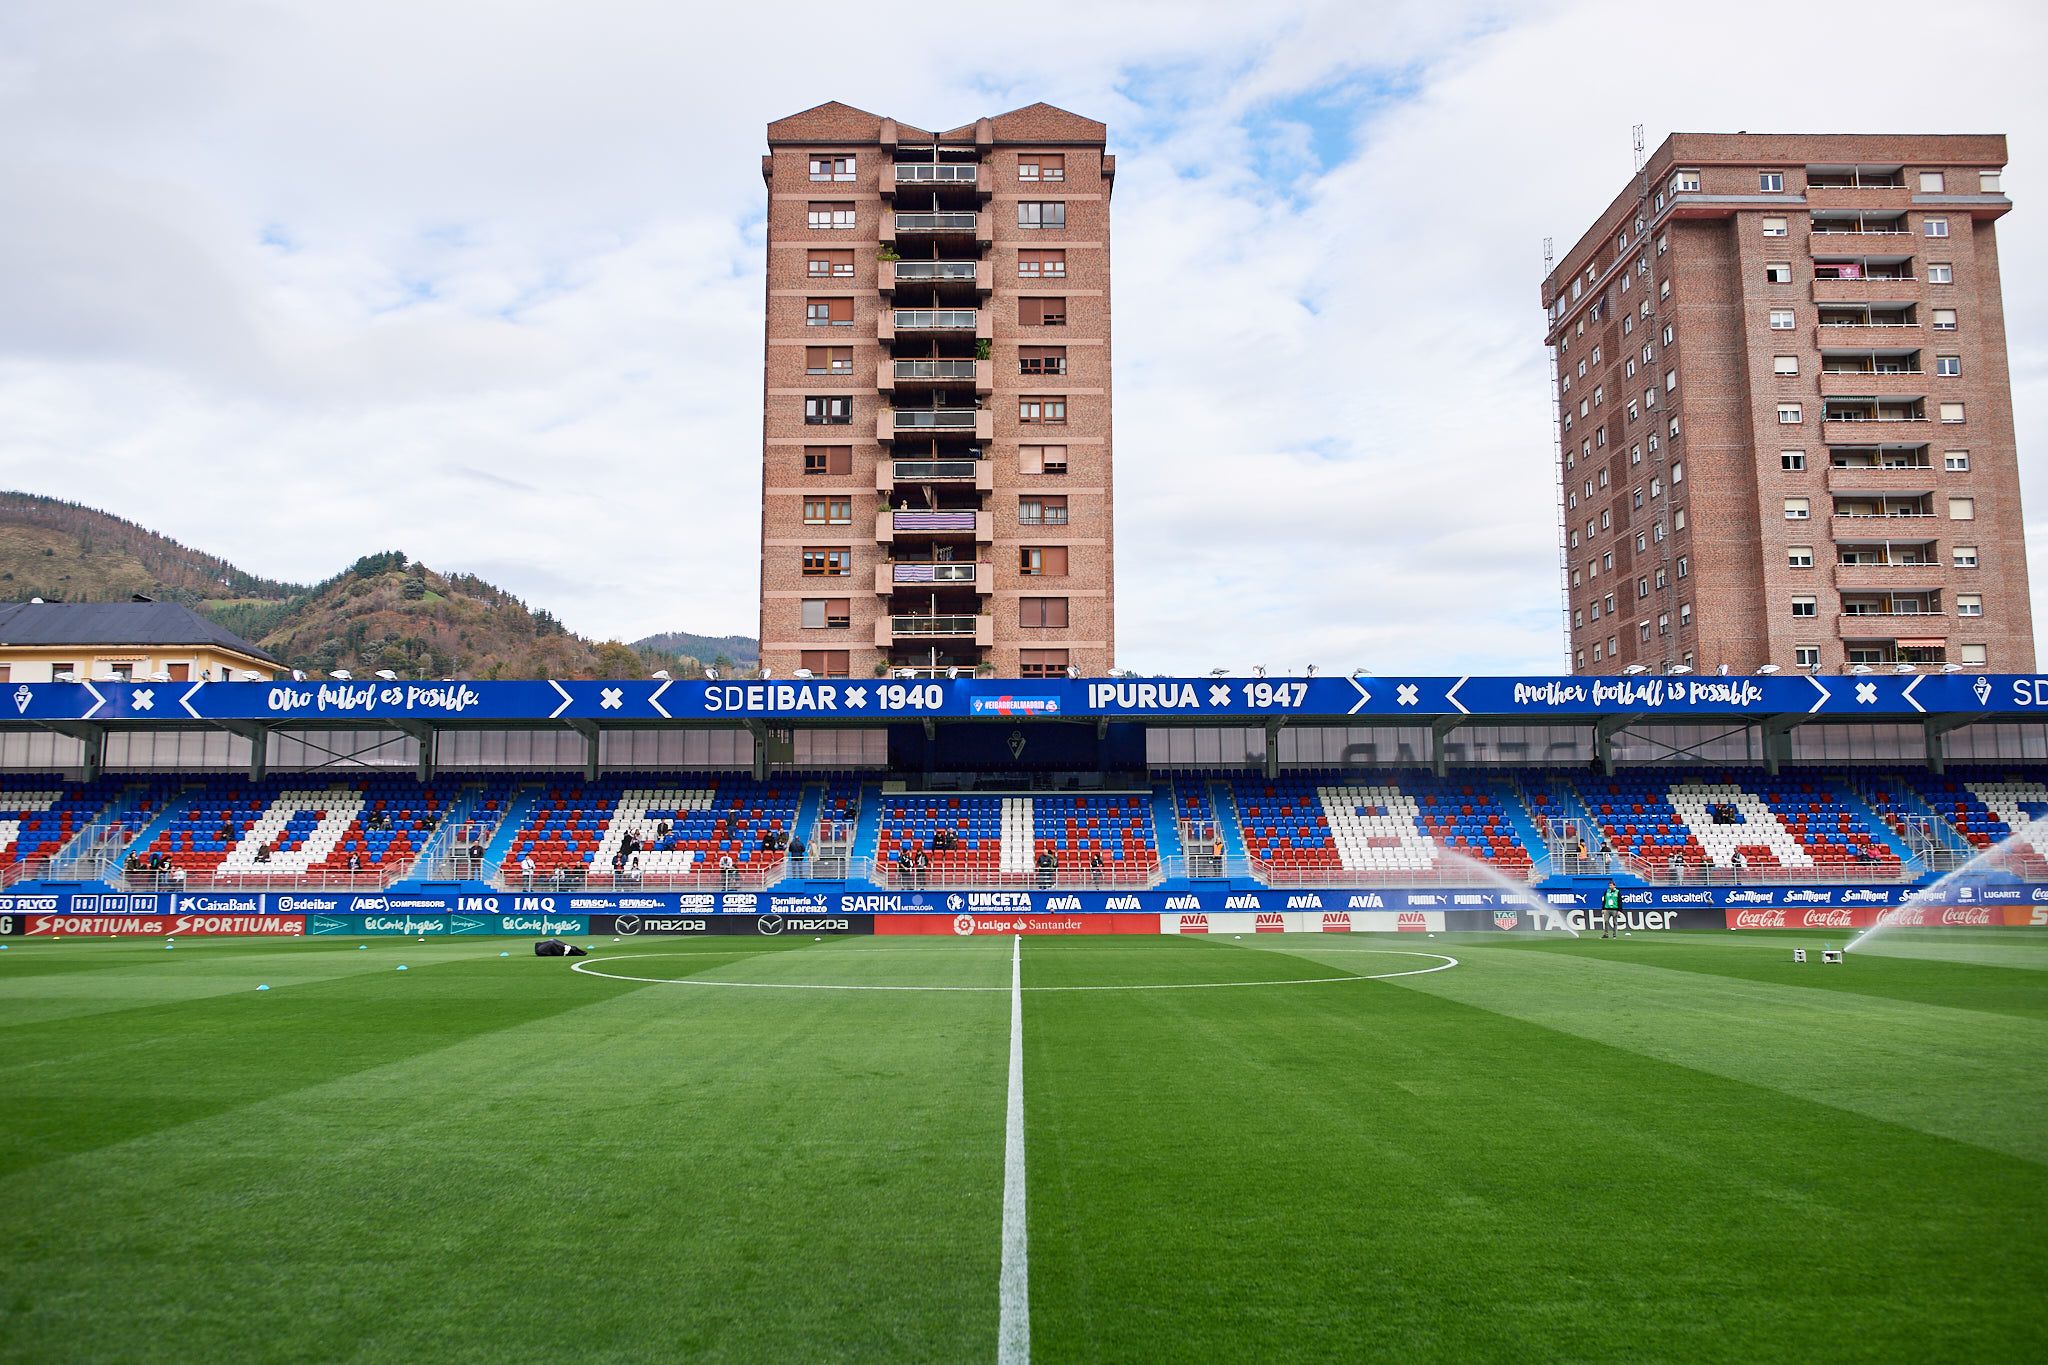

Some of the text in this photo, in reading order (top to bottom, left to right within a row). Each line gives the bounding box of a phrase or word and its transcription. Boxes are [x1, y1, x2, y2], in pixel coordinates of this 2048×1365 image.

[268, 687, 314, 711] Otro
[317, 683, 378, 711] futbol
[380, 687, 404, 705] es
[875, 684, 944, 710] 1940
[1088, 682, 1309, 709] IPURUA 1947
[1514, 681, 1588, 706] Another
[1592, 679, 1664, 706] football
[1668, 682, 1686, 701] is
[770, 896, 812, 905] Tornillería
[968, 892, 1032, 906] UNCETA
[1408, 895, 1437, 905] PUMA
[1454, 895, 1483, 905] PUMA
[1547, 893, 1577, 904] PUMA
[1661, 892, 1709, 903] euskaltel
[1983, 891, 2021, 899] LUGARITZ
[17, 899, 57, 910] ALYCO
[196, 897, 257, 911] CaixaBank
[293, 898, 338, 910] sdeibar
[390, 900, 446, 908] COMPRESSORS
[457, 897, 500, 913] IMQ
[513, 897, 557, 912] IMQ
[770, 904, 828, 913] San Lorenzo
[841, 895, 902, 912] SARIKI
[1495, 911, 1516, 919] TAG
[1736, 909, 1787, 927] Coca-Cola
[1802, 909, 1854, 927] Coca-Cola
[1942, 907, 1991, 925] Coca-Cola
[0, 915, 13, 935] G
[25, 915, 163, 936] SPORTIUM.es
[164, 915, 304, 936] SPORTIUM.es
[977, 918, 1083, 931] LaLiga Santander
